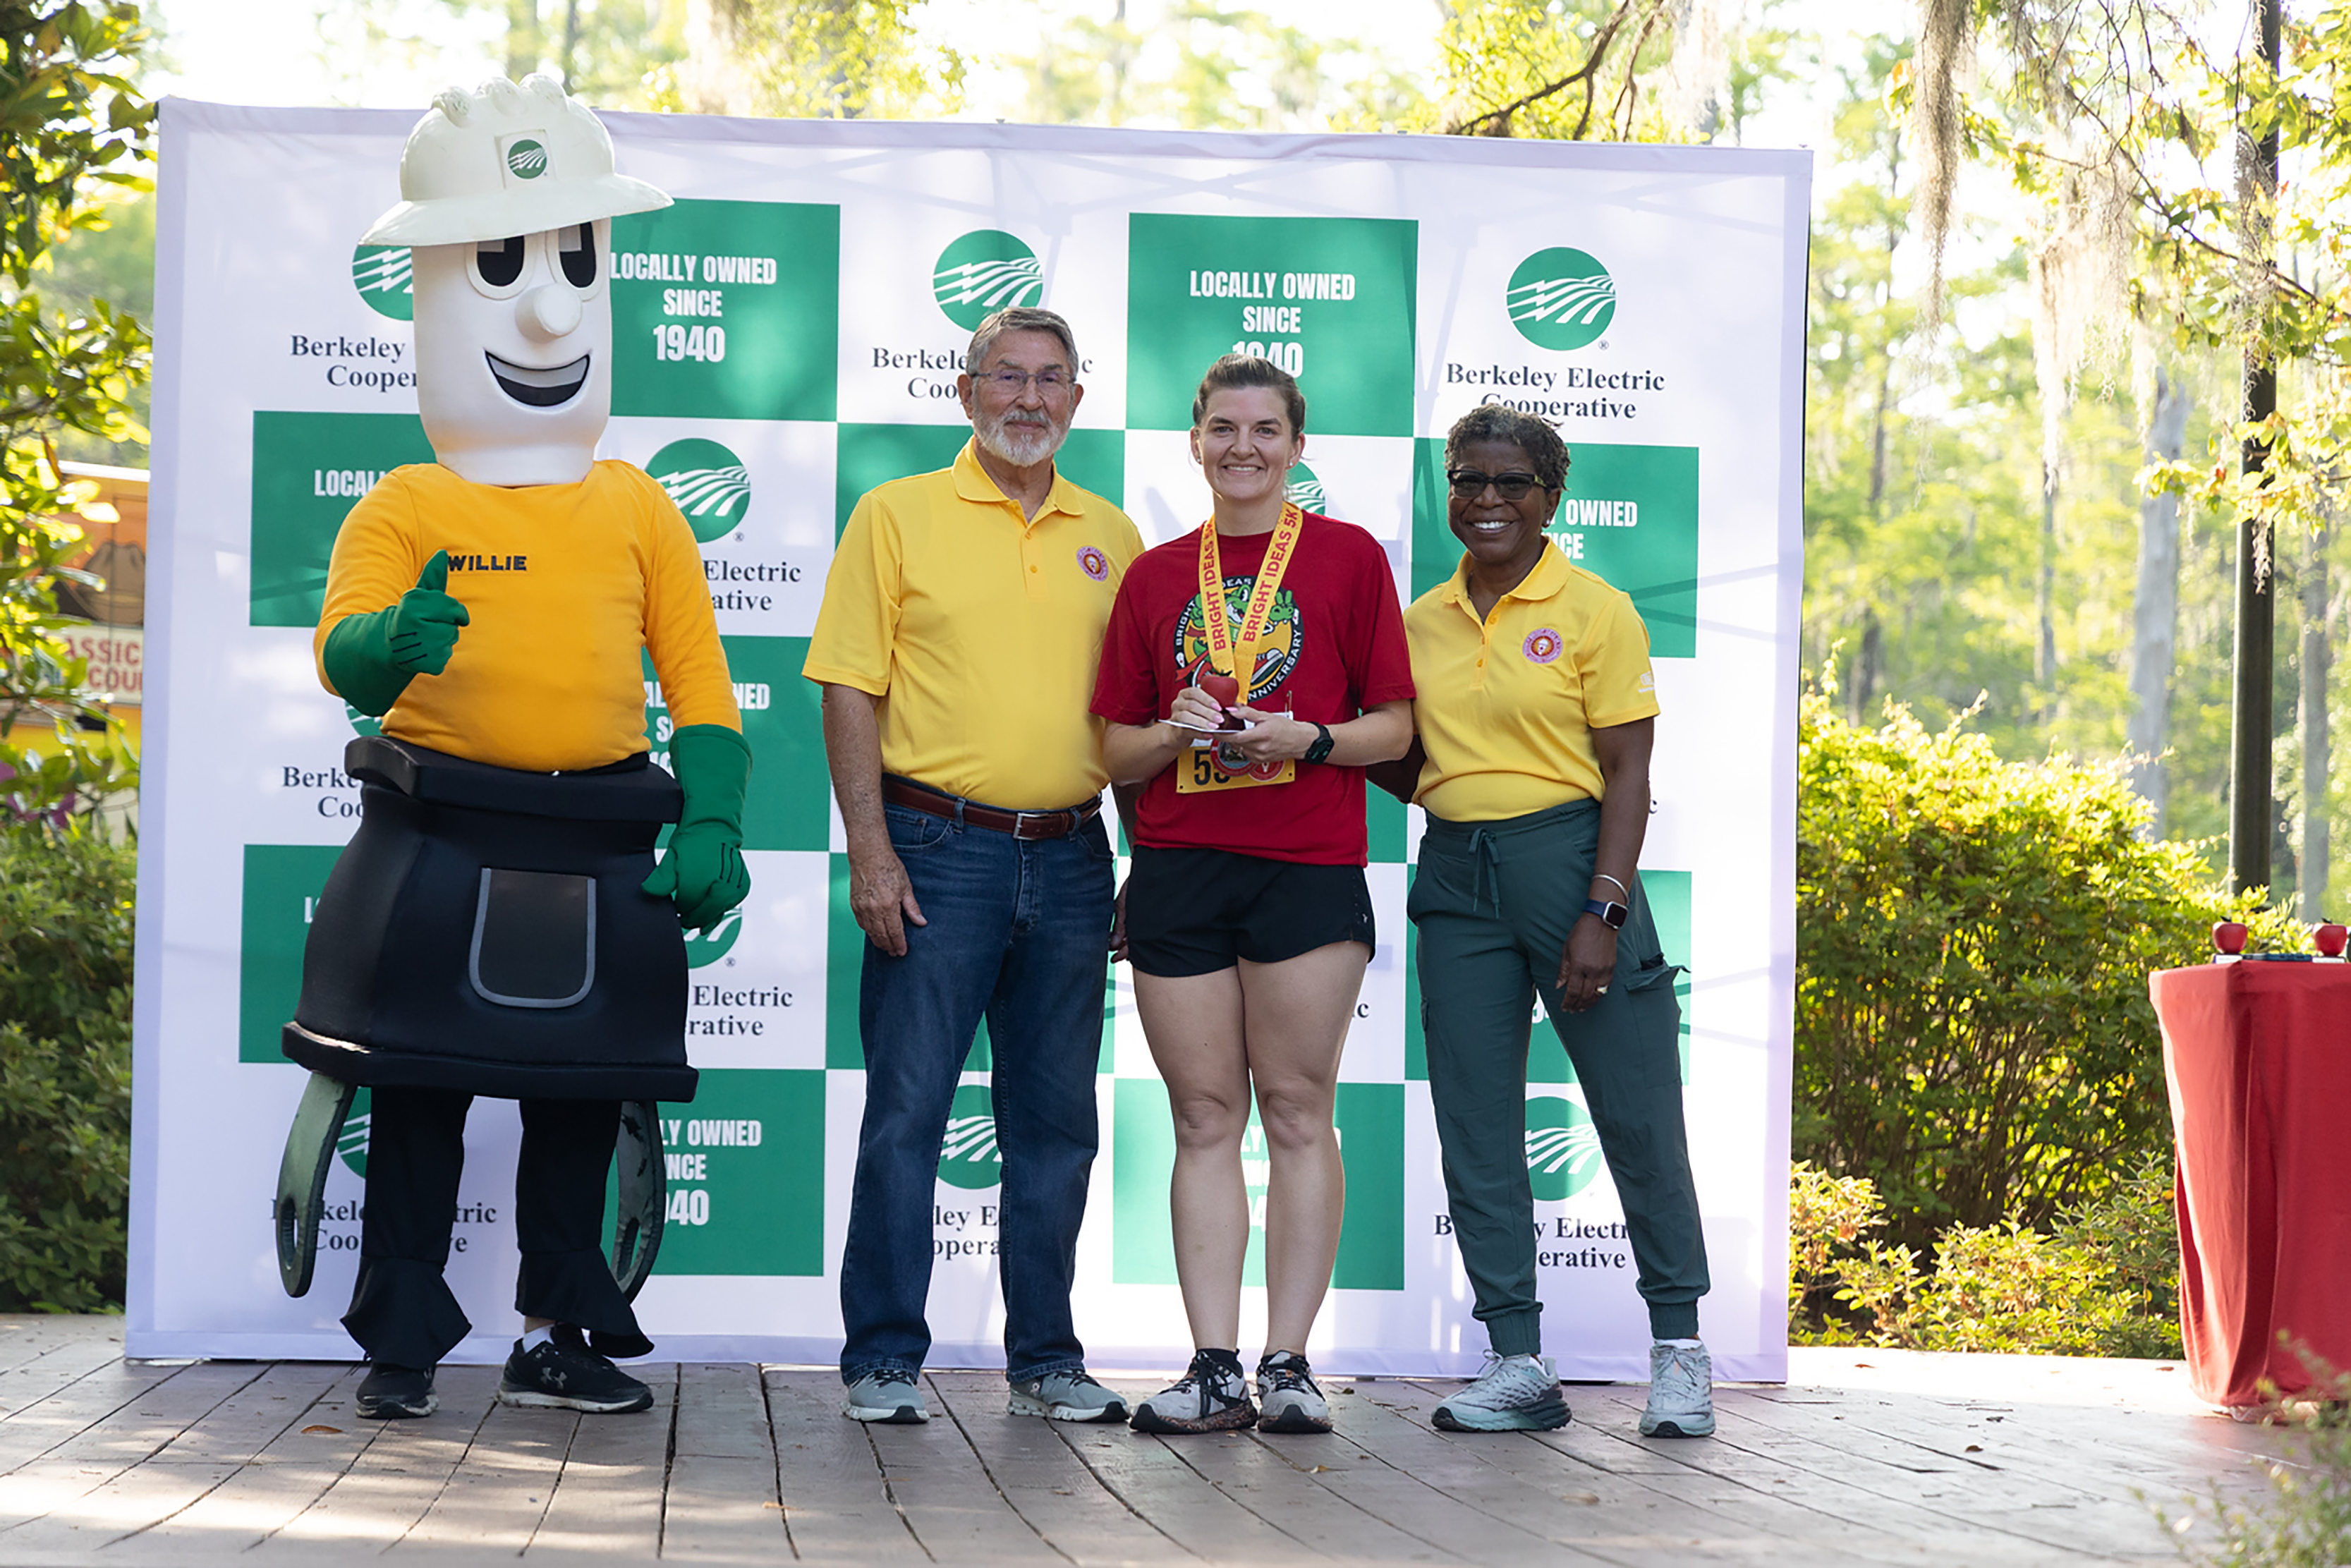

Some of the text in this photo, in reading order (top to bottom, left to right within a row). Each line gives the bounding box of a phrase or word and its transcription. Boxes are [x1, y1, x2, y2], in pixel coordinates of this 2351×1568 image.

[610, 253, 777, 284] LOCALLY OWNED
[1190, 271, 1355, 300] LOCALLY OWNED
[663, 288, 722, 317] SINCE
[1243, 306, 1301, 333] SINCE
[291, 335, 406, 364] Berkeley
[653, 324, 725, 362] 1940
[873, 347, 966, 369] Berkele
[1447, 363, 1665, 392] Berkeley Electric
[315, 470, 385, 497] LOCAL
[1566, 499, 1637, 527] OWNED
[448, 555, 527, 571] WILLIE
[703, 560, 801, 582] Electric
[1203, 540, 1217, 587] IDEAS
[1243, 509, 1298, 642] BRIGHT IDEAS 5K
[1175, 600, 1196, 646] BRIGHT
[1205, 590, 1227, 651] BRIGHT
[64, 637, 140, 666] ASSIC
[1248, 629, 1301, 700] NNIVERSARY
[693, 985, 793, 1007] Electric
[689, 1015, 764, 1035] rative
[687, 1119, 761, 1146] OWNED
[1538, 1247, 1626, 1268] erative
